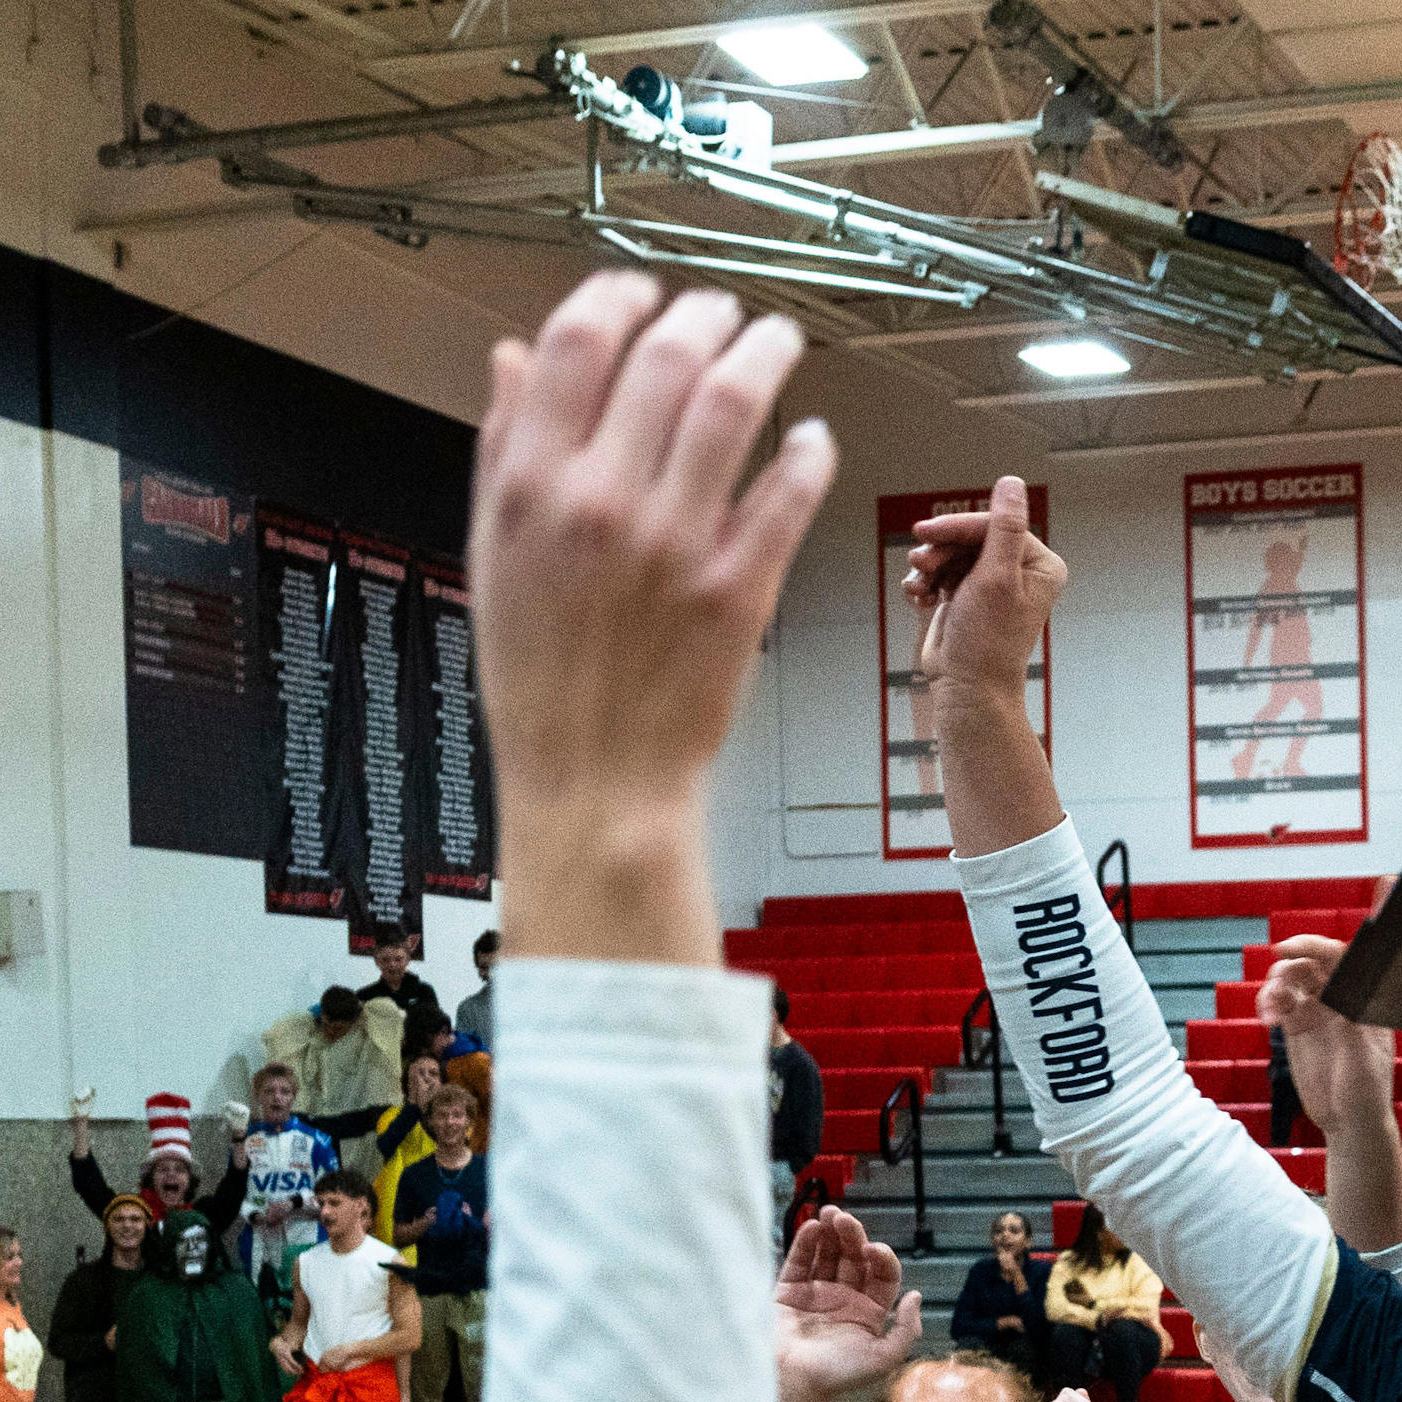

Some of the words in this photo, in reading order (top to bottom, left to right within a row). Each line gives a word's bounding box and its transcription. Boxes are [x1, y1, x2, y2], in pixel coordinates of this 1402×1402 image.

[1191, 479, 1257, 508] BOYS
[1262, 473, 1356, 501] SOCCER
[1013, 893, 1116, 1105] ROCKFORD
[251, 1171, 313, 1193] VISA
